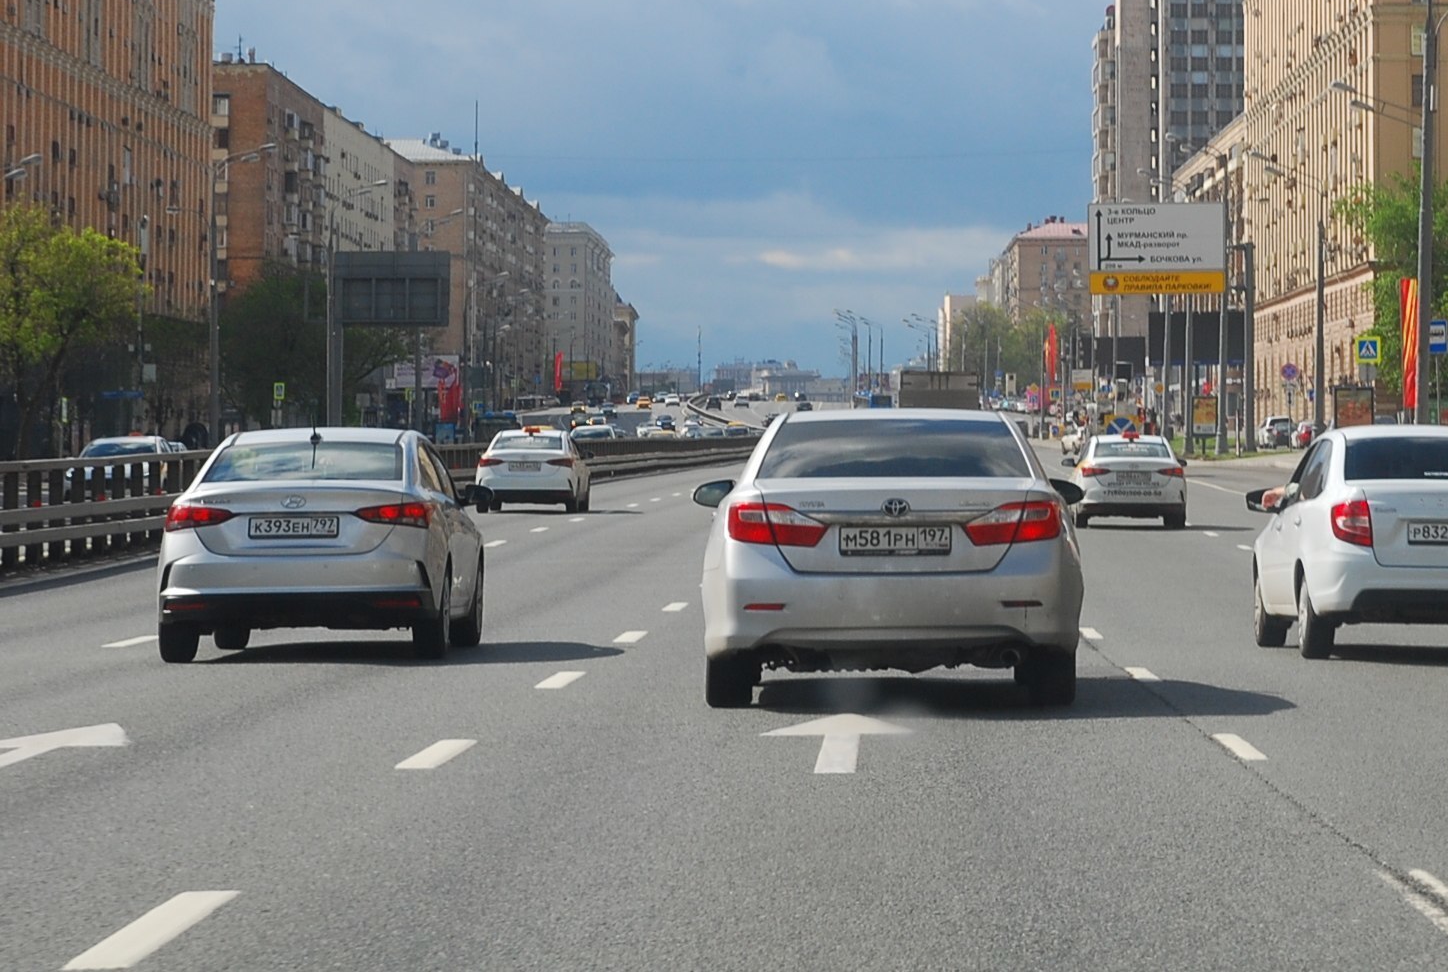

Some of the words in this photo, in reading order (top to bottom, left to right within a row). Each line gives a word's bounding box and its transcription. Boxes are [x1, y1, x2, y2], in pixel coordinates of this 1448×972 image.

[1121, 208, 1156, 216] КОЛЬЦО
[1107, 217, 1135, 225] ЦЕНТР
[1117, 231, 1175, 239] МУРМАНСКИЙ
[1117, 241, 1180, 249] МКАД-разворот
[1123, 275, 1181, 283] СОБЛЮДАЙТЕ
[1123, 283, 1163, 292] ПРАВИЛА
[253, 519, 310, 534] К393ЕН
[312, 518, 335, 530] 797
[844, 530, 915, 547] М581РН
[920, 528, 945, 542] 197
